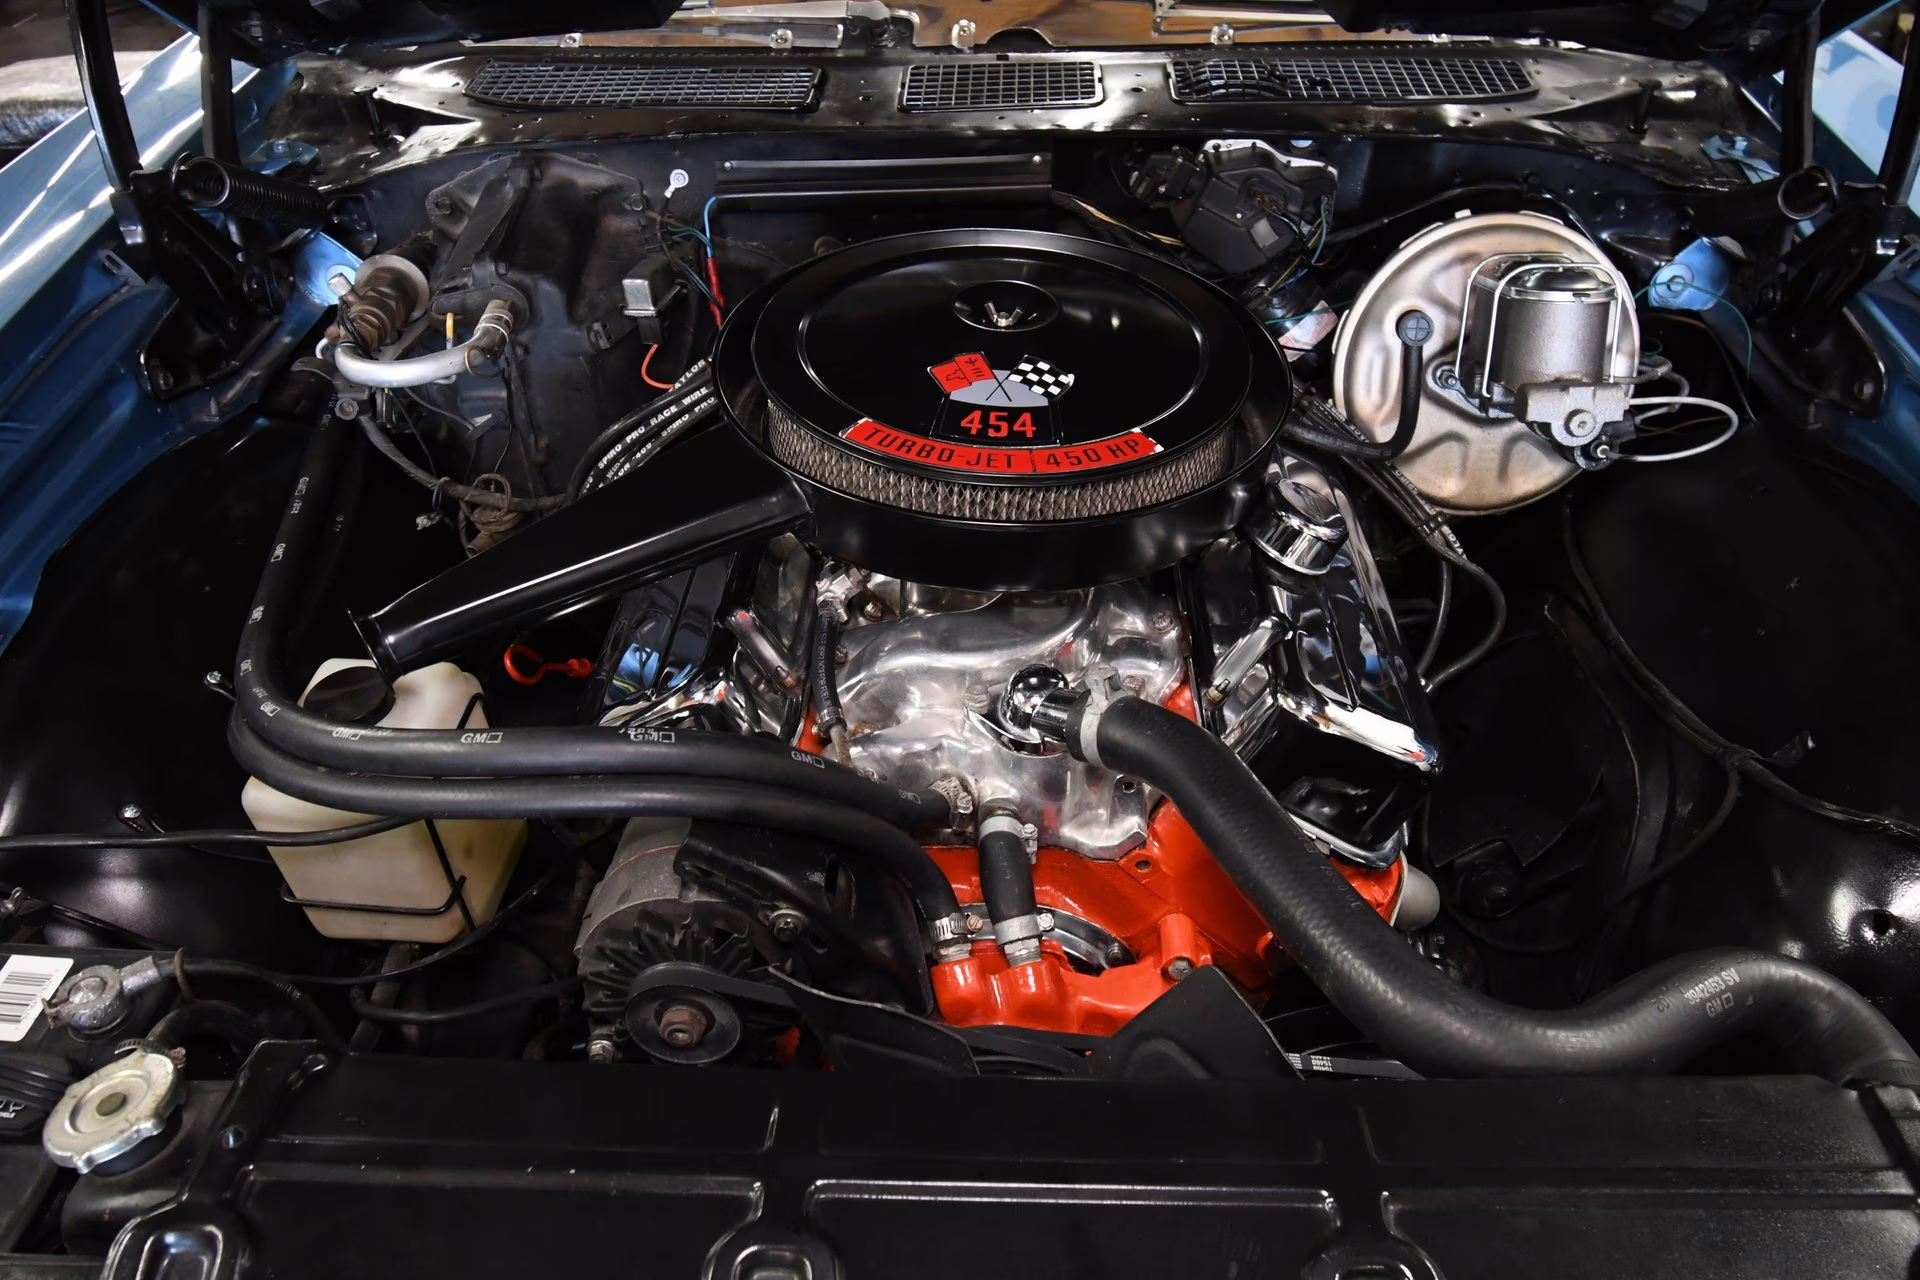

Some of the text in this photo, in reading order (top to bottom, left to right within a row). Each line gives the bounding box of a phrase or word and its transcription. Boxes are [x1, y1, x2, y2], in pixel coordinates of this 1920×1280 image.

[598, 386, 709, 469] SPIRO PRO RACE WIRE
[661, 413, 690, 437] SPIRO
[694, 396, 716, 413] PRO
[960, 410, 1037, 438] 454
[864, 426, 1142, 469] TURBO-JET 450 HP
[460, 733, 489, 744] GM
[791, 751, 814, 763] GM
[1721, 967, 1740, 986] SV
[1706, 997, 1722, 1017] GM
